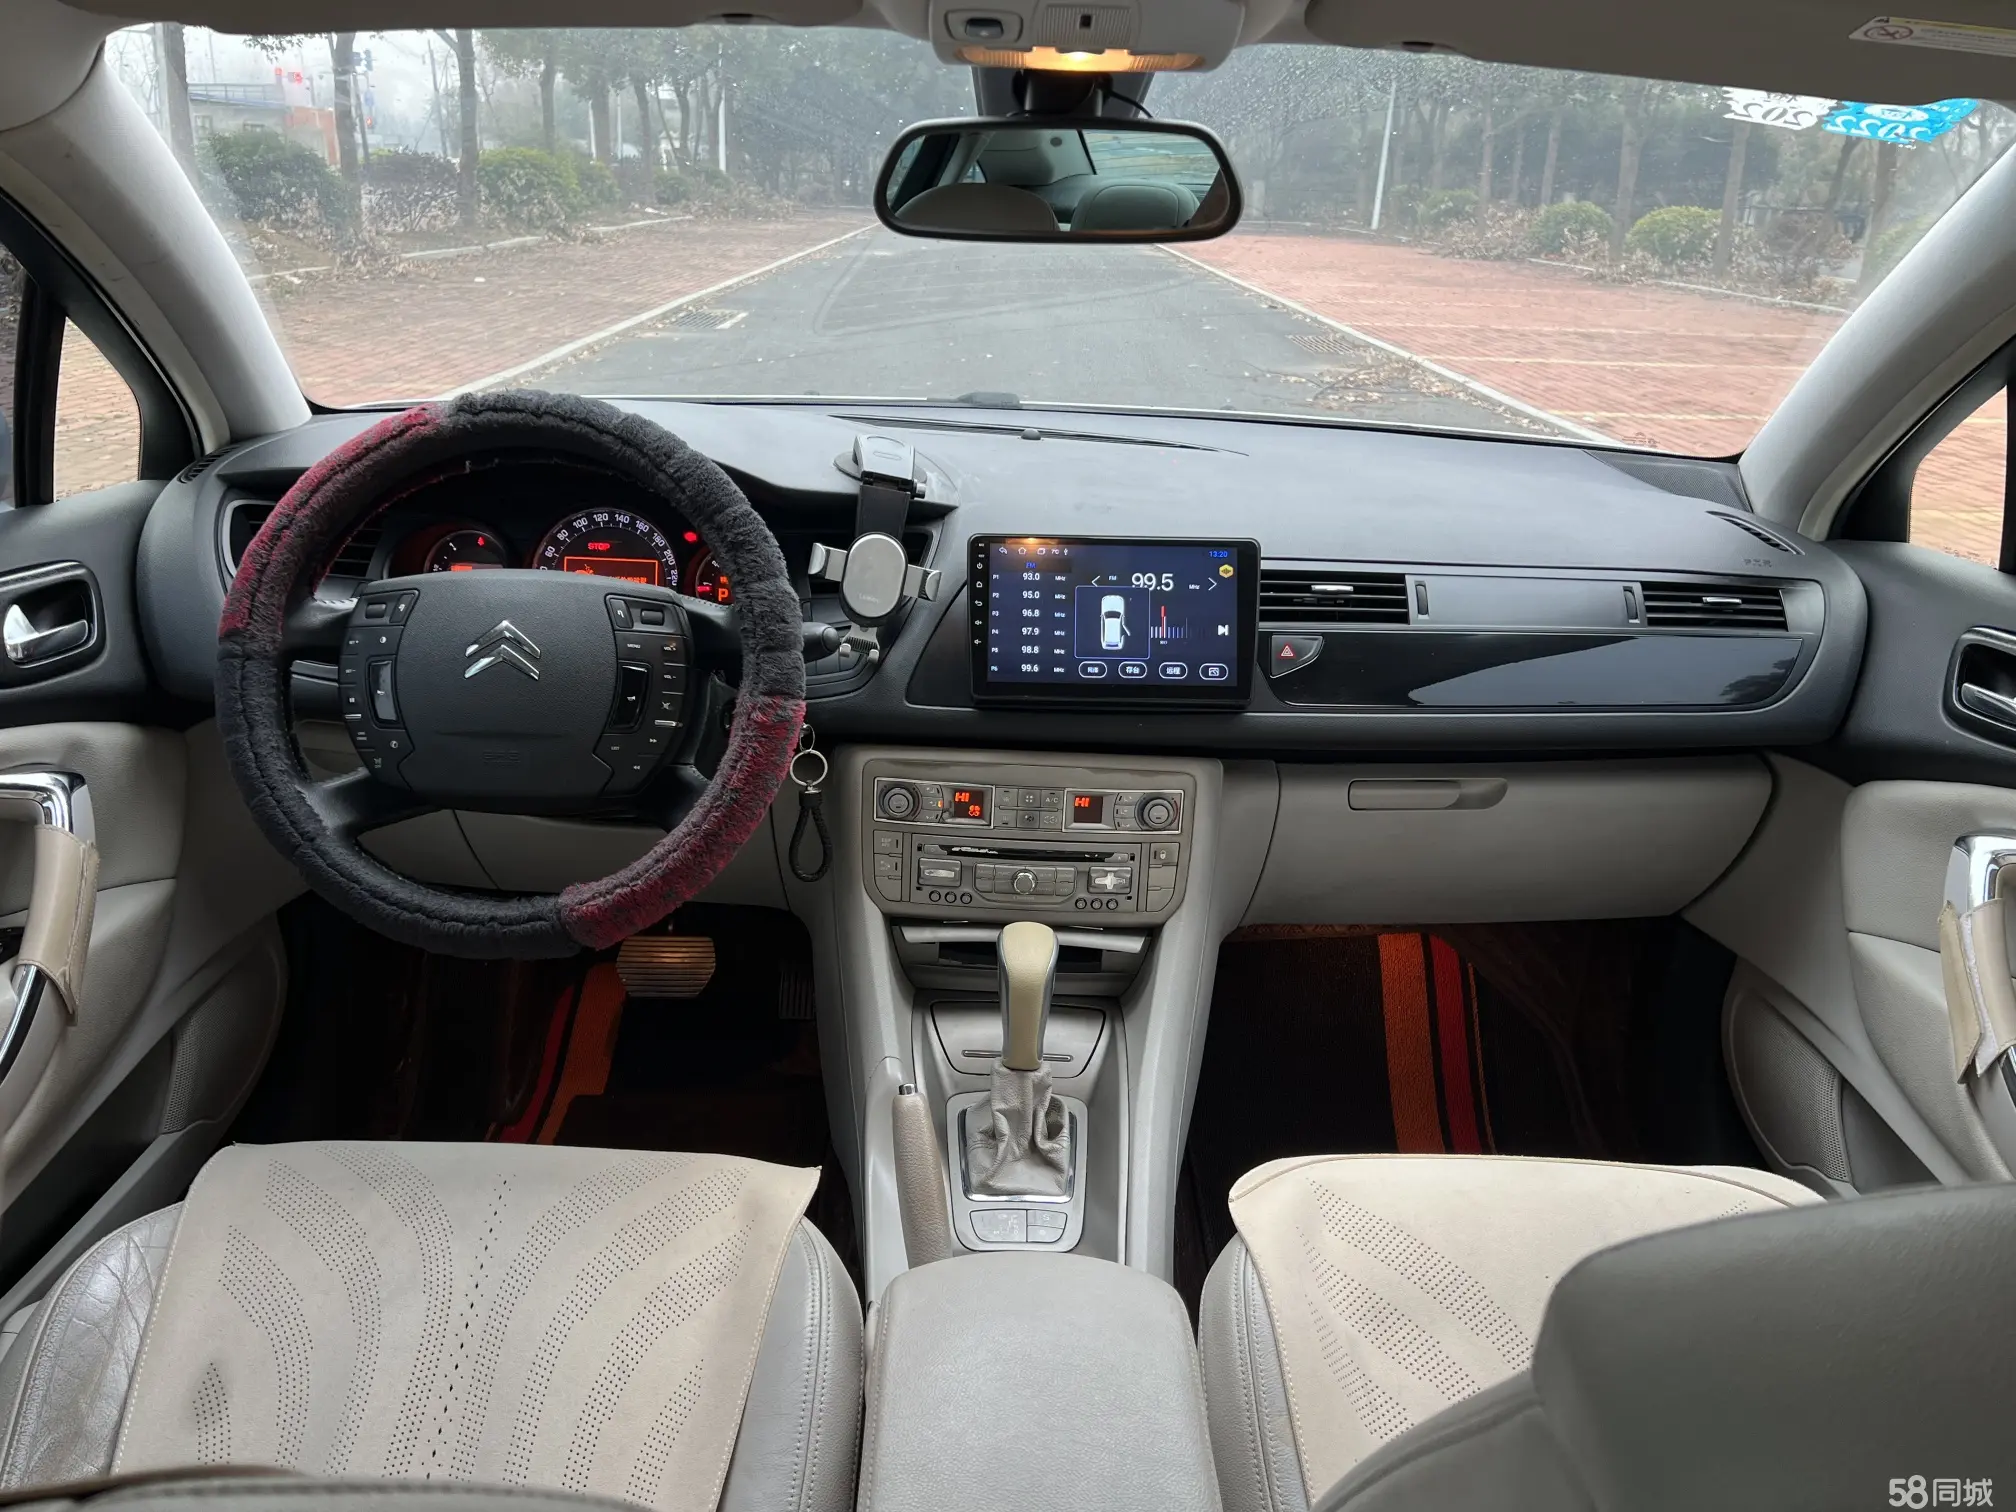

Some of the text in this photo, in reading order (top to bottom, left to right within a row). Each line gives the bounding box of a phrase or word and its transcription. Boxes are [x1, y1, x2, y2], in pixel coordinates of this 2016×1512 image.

[593, 513, 609, 522] 120
[614, 513, 630, 525] 140
[572, 517, 588, 529] 100
[635, 519, 650, 533] 160
[557, 529, 569, 541] 80
[651, 532, 665, 547] 180
[544, 545, 556, 558] 60
[587, 542, 611, 551] STOP
[663, 549, 676, 566] 200
[1022, 572, 1040, 581] 93.0
[1131, 572, 1174, 592] 99.5
[718, 588, 729, 602] P
[1022, 590, 1040, 599] 95.0
[1022, 609, 1040, 617] 96.8
[1021, 627, 1040, 636] 97.9
[1021, 645, 1039, 654] 98.8
[1021, 664, 1039, 672] 99.6
[954, 792, 970, 802] HI
[1074, 797, 1090, 807] HI
